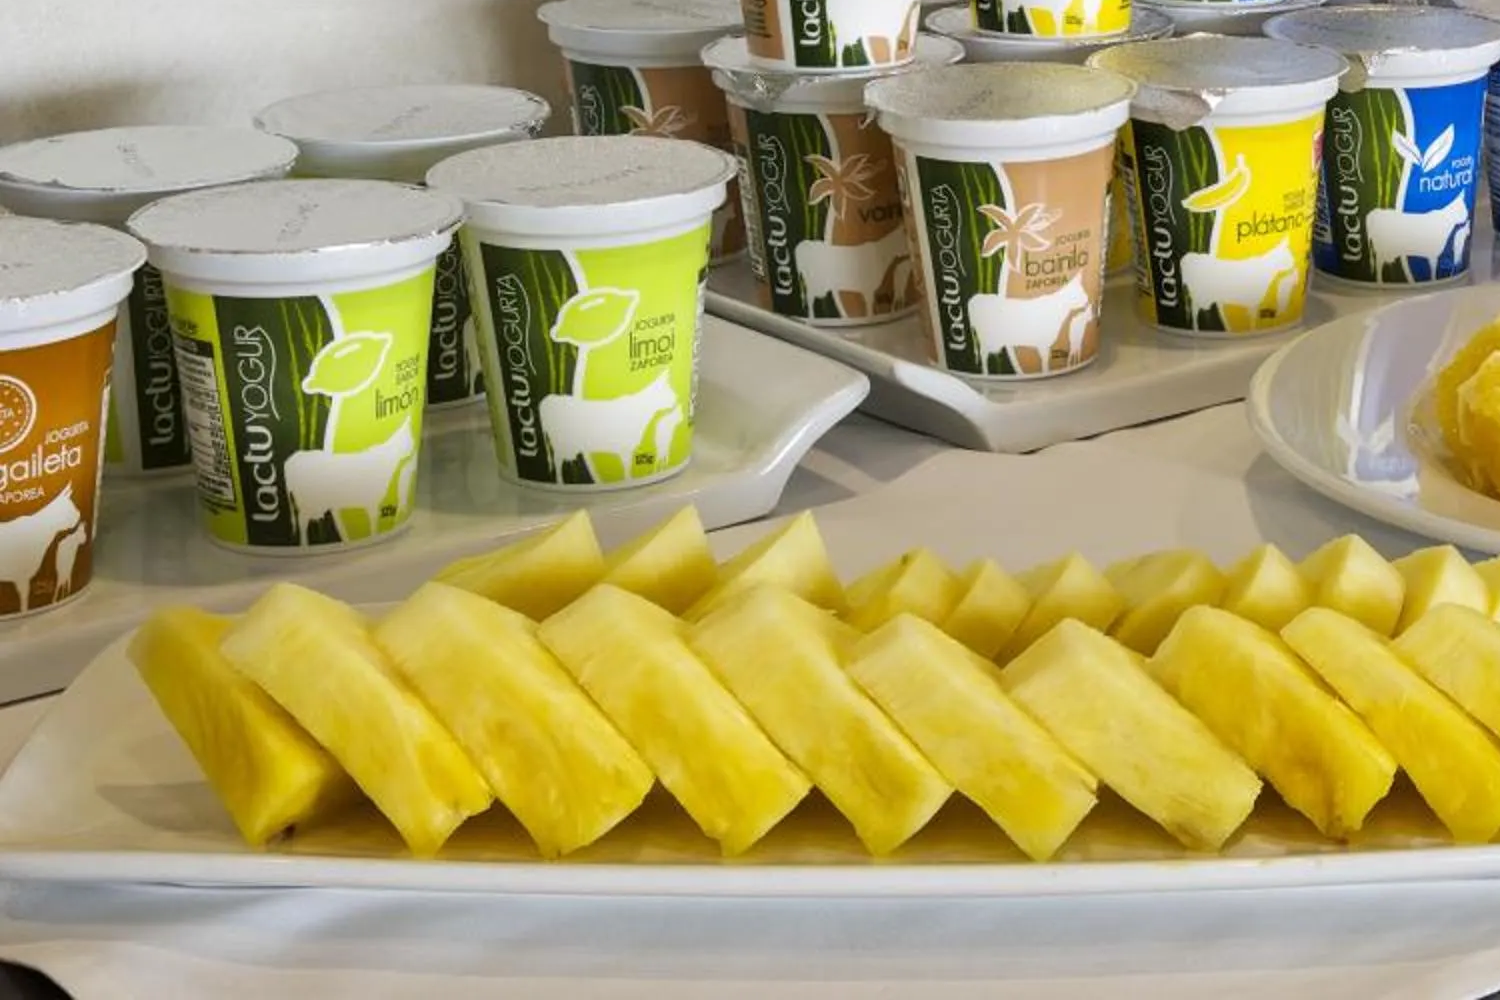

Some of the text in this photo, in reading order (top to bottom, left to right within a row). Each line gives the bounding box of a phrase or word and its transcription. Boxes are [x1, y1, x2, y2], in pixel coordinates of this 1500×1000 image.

[1236, 211, 1304, 244] plátano
[629, 328, 675, 359] limoi
[233, 323, 280, 522] lactuYOGUR
